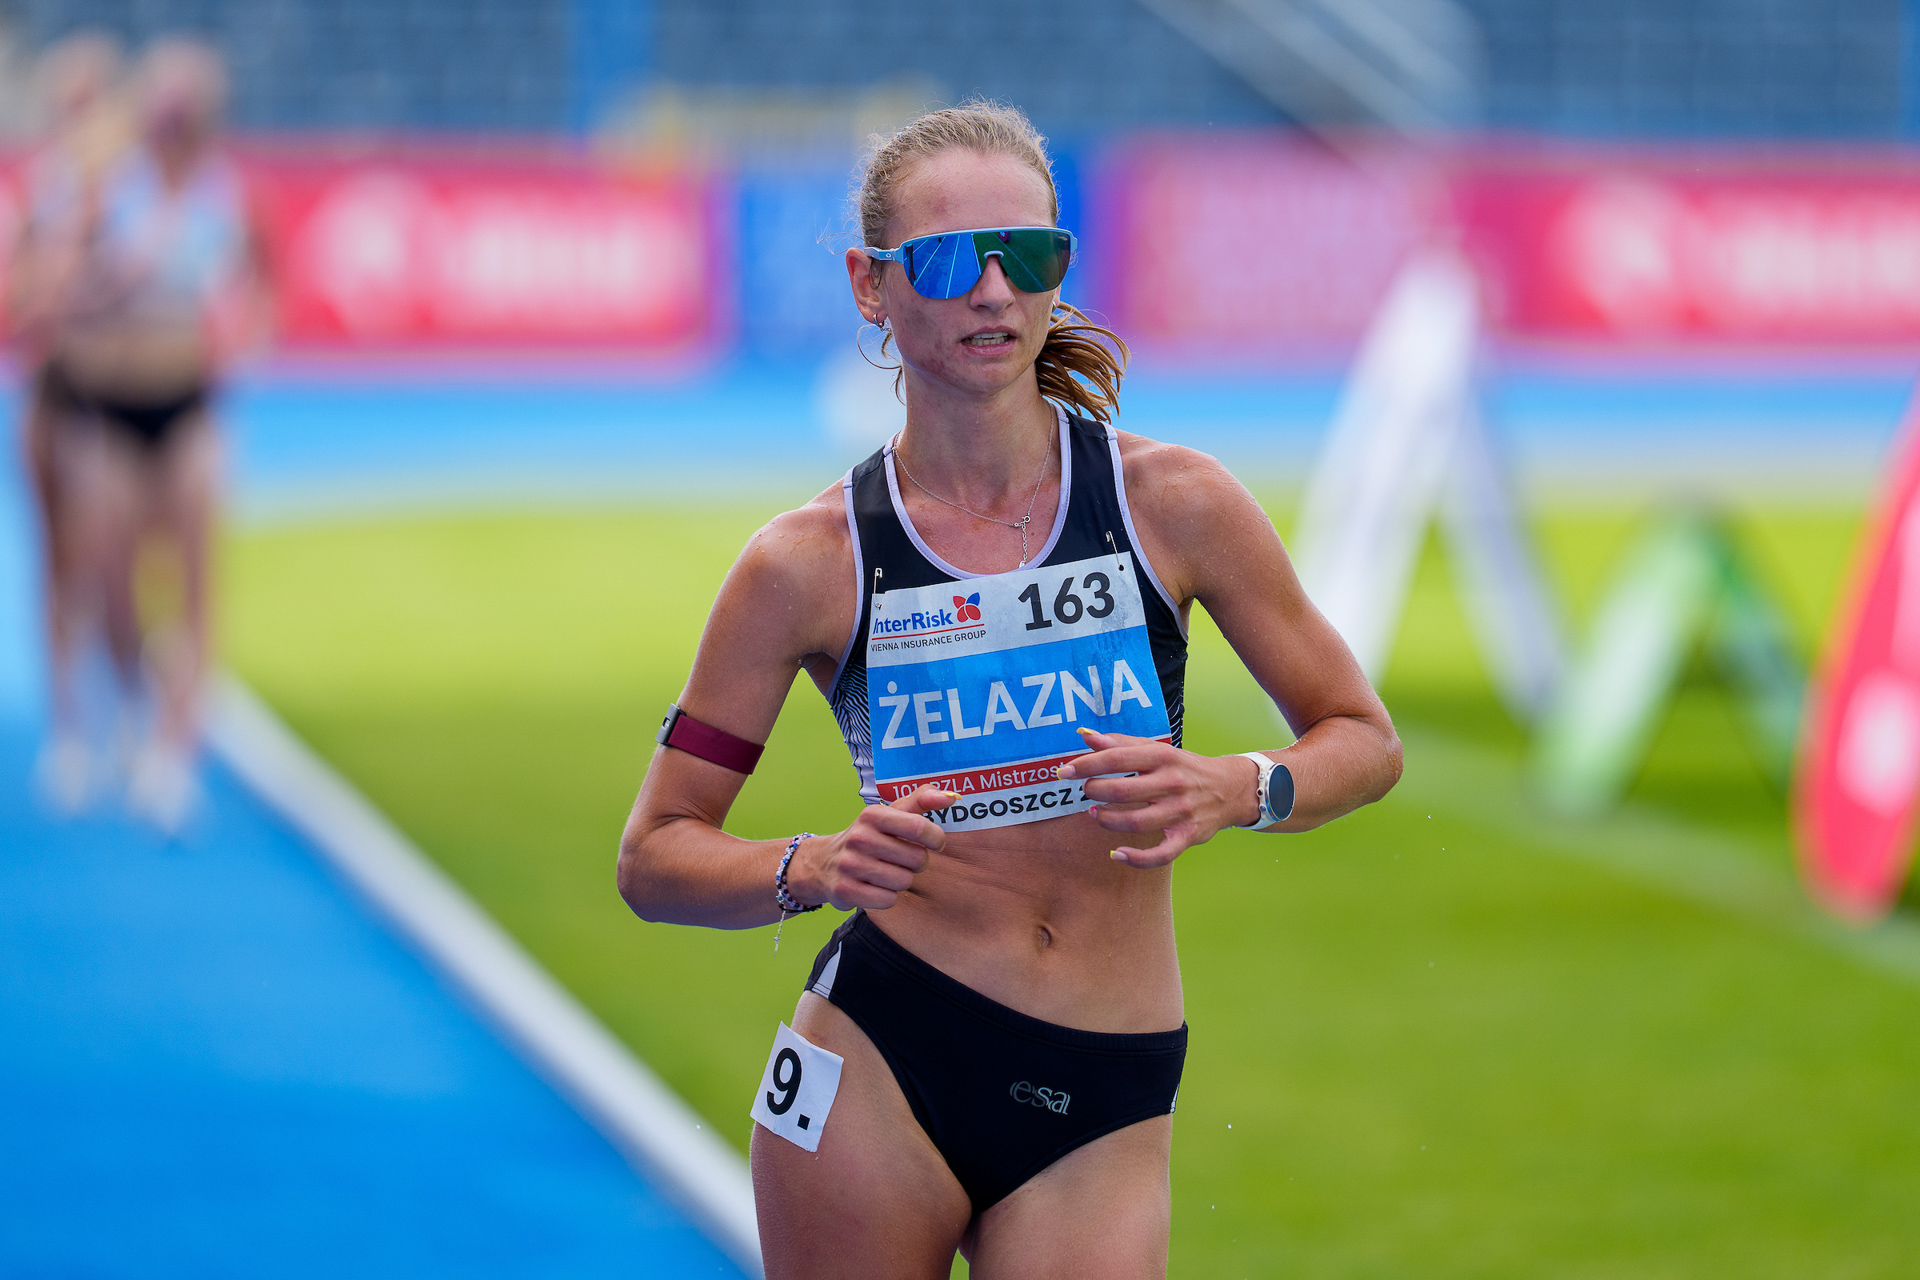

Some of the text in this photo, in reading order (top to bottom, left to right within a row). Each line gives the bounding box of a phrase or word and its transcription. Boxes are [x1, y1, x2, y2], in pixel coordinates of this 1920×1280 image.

[873, 609, 954, 635] InterRisk
[1018, 572, 1115, 631] 163
[871, 630, 987, 652] VIENNA INSURANCE GROUP
[878, 659, 1153, 749] ŻELAZNA
[766, 1047, 811, 1131] 9.
